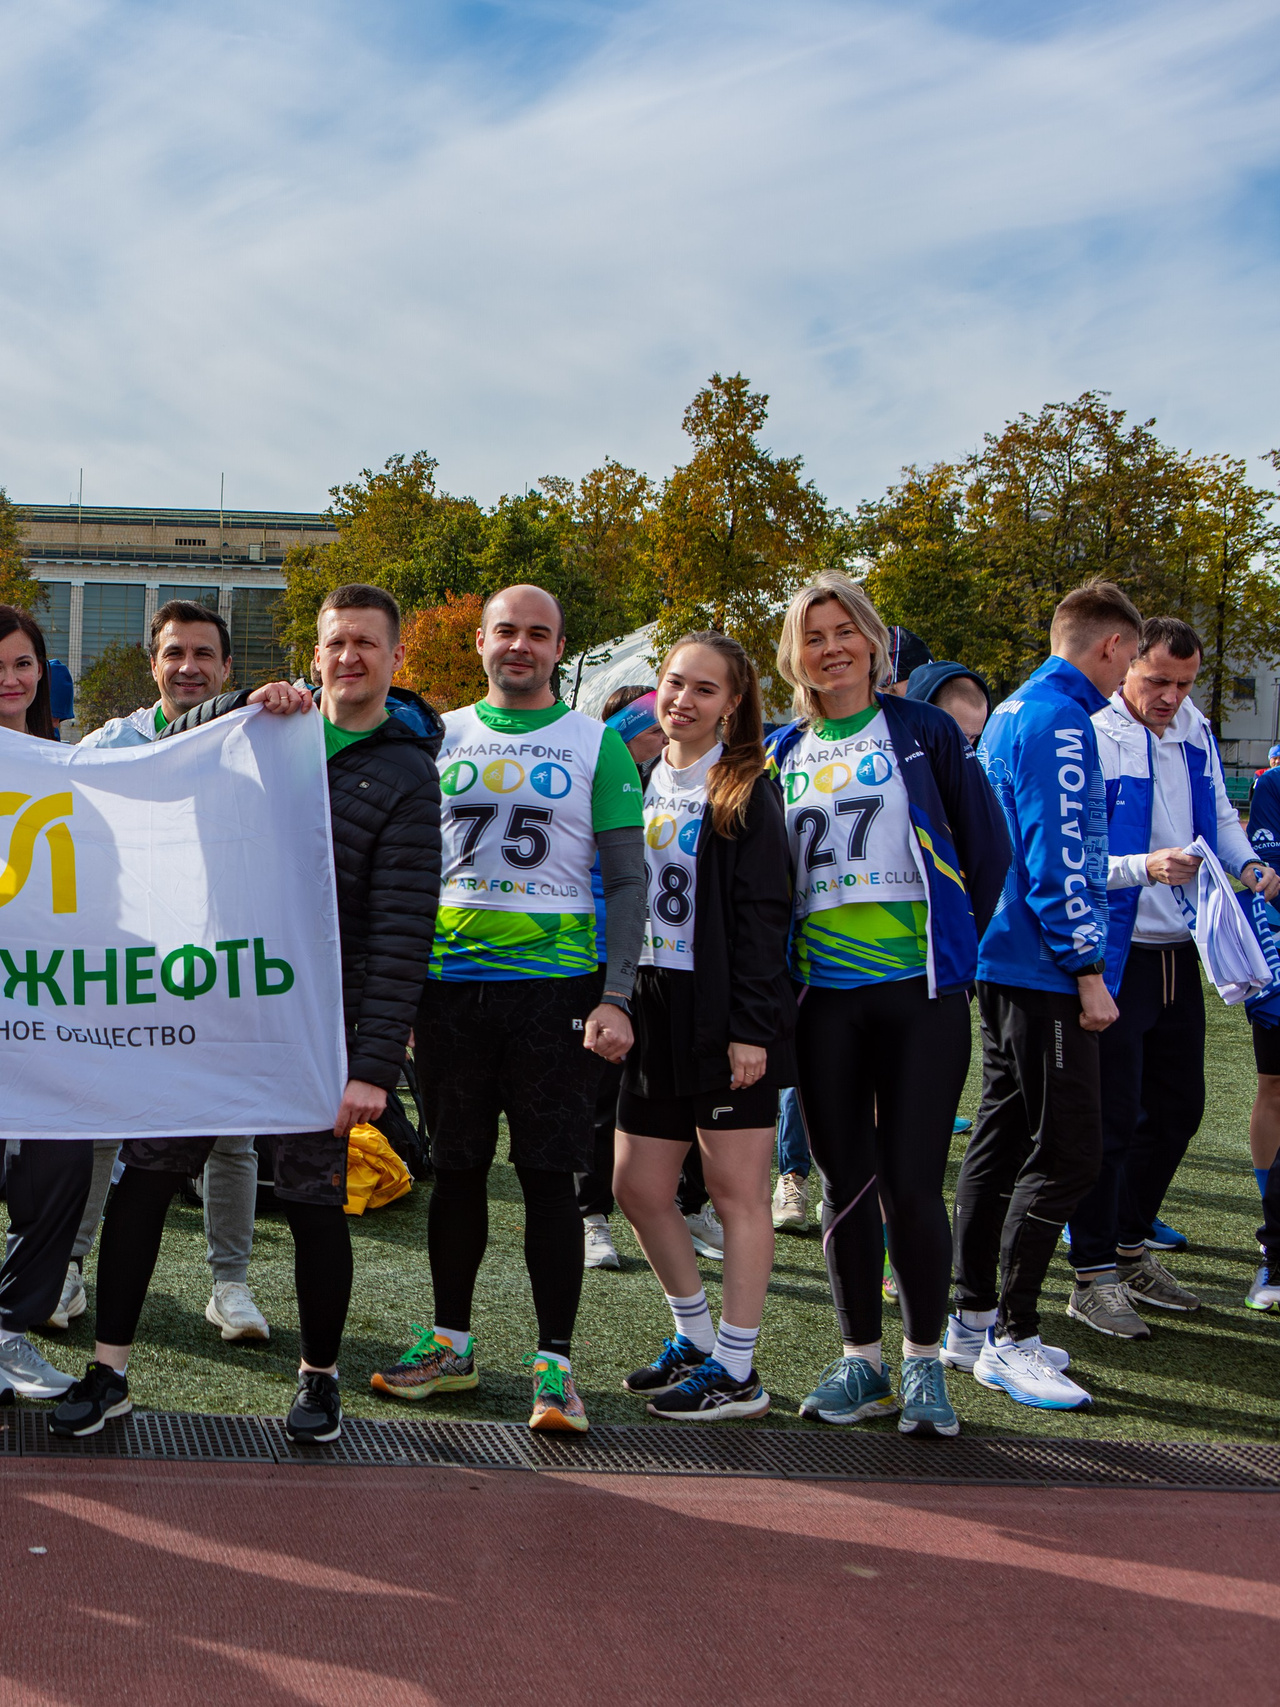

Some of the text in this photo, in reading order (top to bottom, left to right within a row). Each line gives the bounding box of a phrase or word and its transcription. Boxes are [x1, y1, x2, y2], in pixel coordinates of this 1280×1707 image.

[446, 743, 573, 762] VMARAFONE
[451, 803, 554, 870] 75
[794, 794, 885, 874] 27
[1054, 728, 1093, 921] РОСАТОМ
[1252, 842, 1280, 851] ОСАТОМ
[441, 877, 579, 898] VMARAFONE.CLUB
[56, 1024, 197, 1047] ОБЩЕСТВО
[1054, 1019, 1064, 1069] noname
